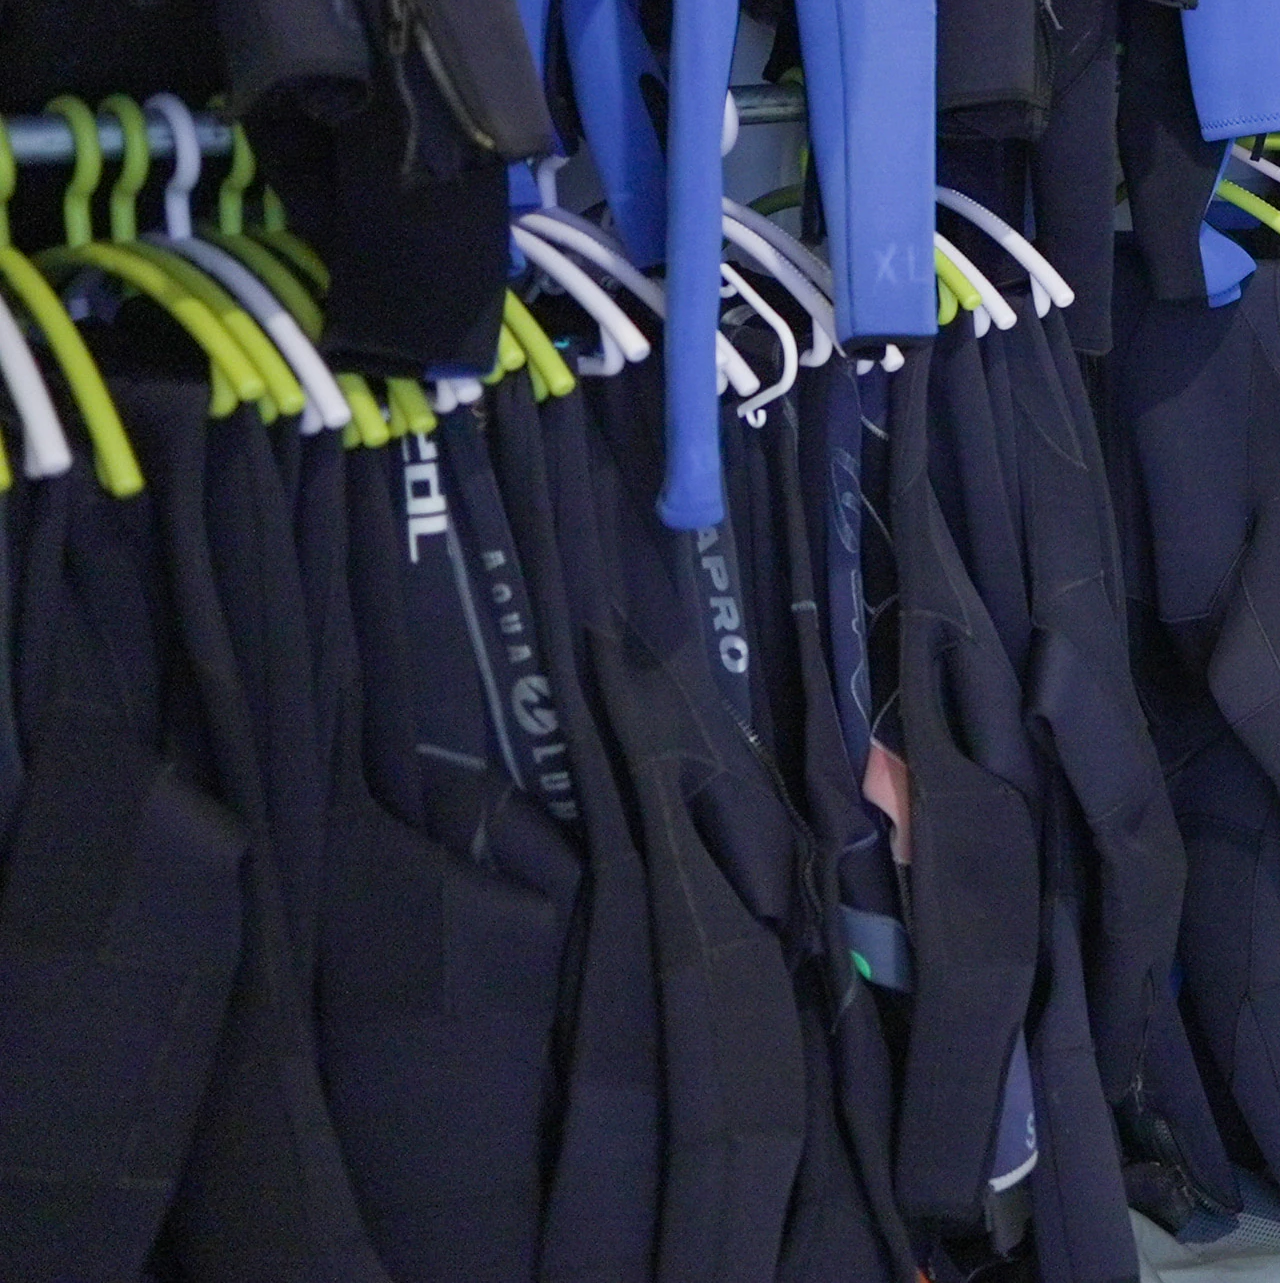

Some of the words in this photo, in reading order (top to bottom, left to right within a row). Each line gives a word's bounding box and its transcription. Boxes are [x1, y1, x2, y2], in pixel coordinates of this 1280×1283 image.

[482, 550, 533, 663] AQUA
[533, 743, 578, 820] LUN
[697, 527, 749, 674] APRO
